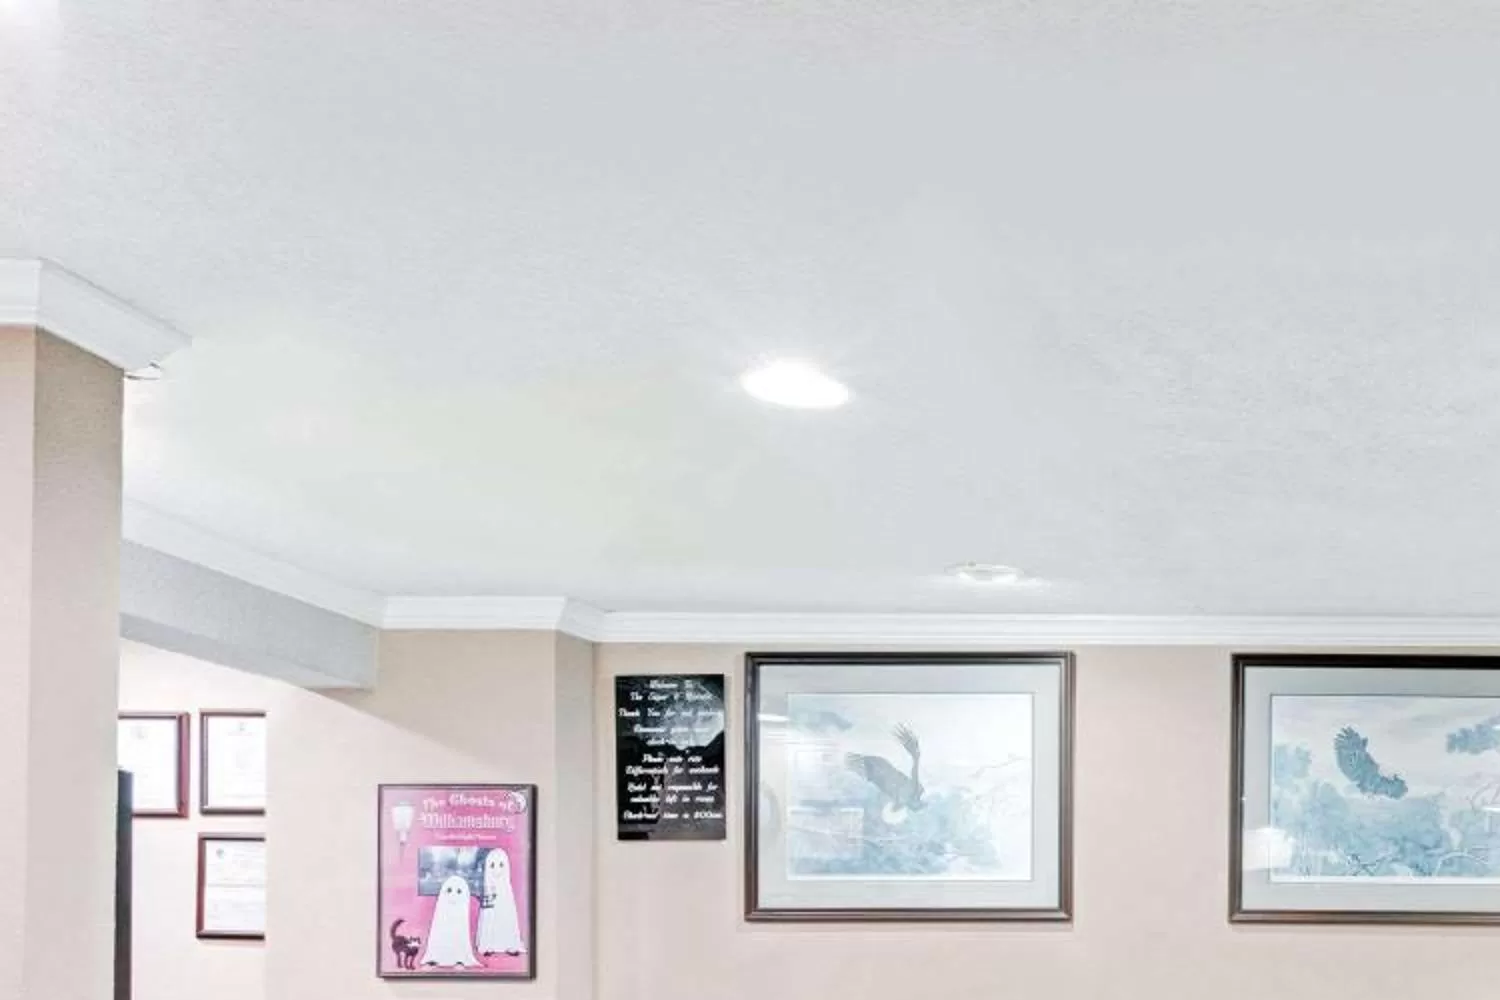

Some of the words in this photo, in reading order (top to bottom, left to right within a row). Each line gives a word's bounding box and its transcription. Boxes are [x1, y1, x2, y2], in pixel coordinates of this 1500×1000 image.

[629, 691, 644, 701] The
[618, 707, 641, 717] Thank
[647, 707, 661, 717] You
[706, 782, 719, 793] for
[422, 796, 446, 812] The
[448, 792, 496, 808] Ghosts
[665, 794, 679, 805] left
[681, 795, 691, 803] in
[416, 811, 516, 833] Williamsburg
